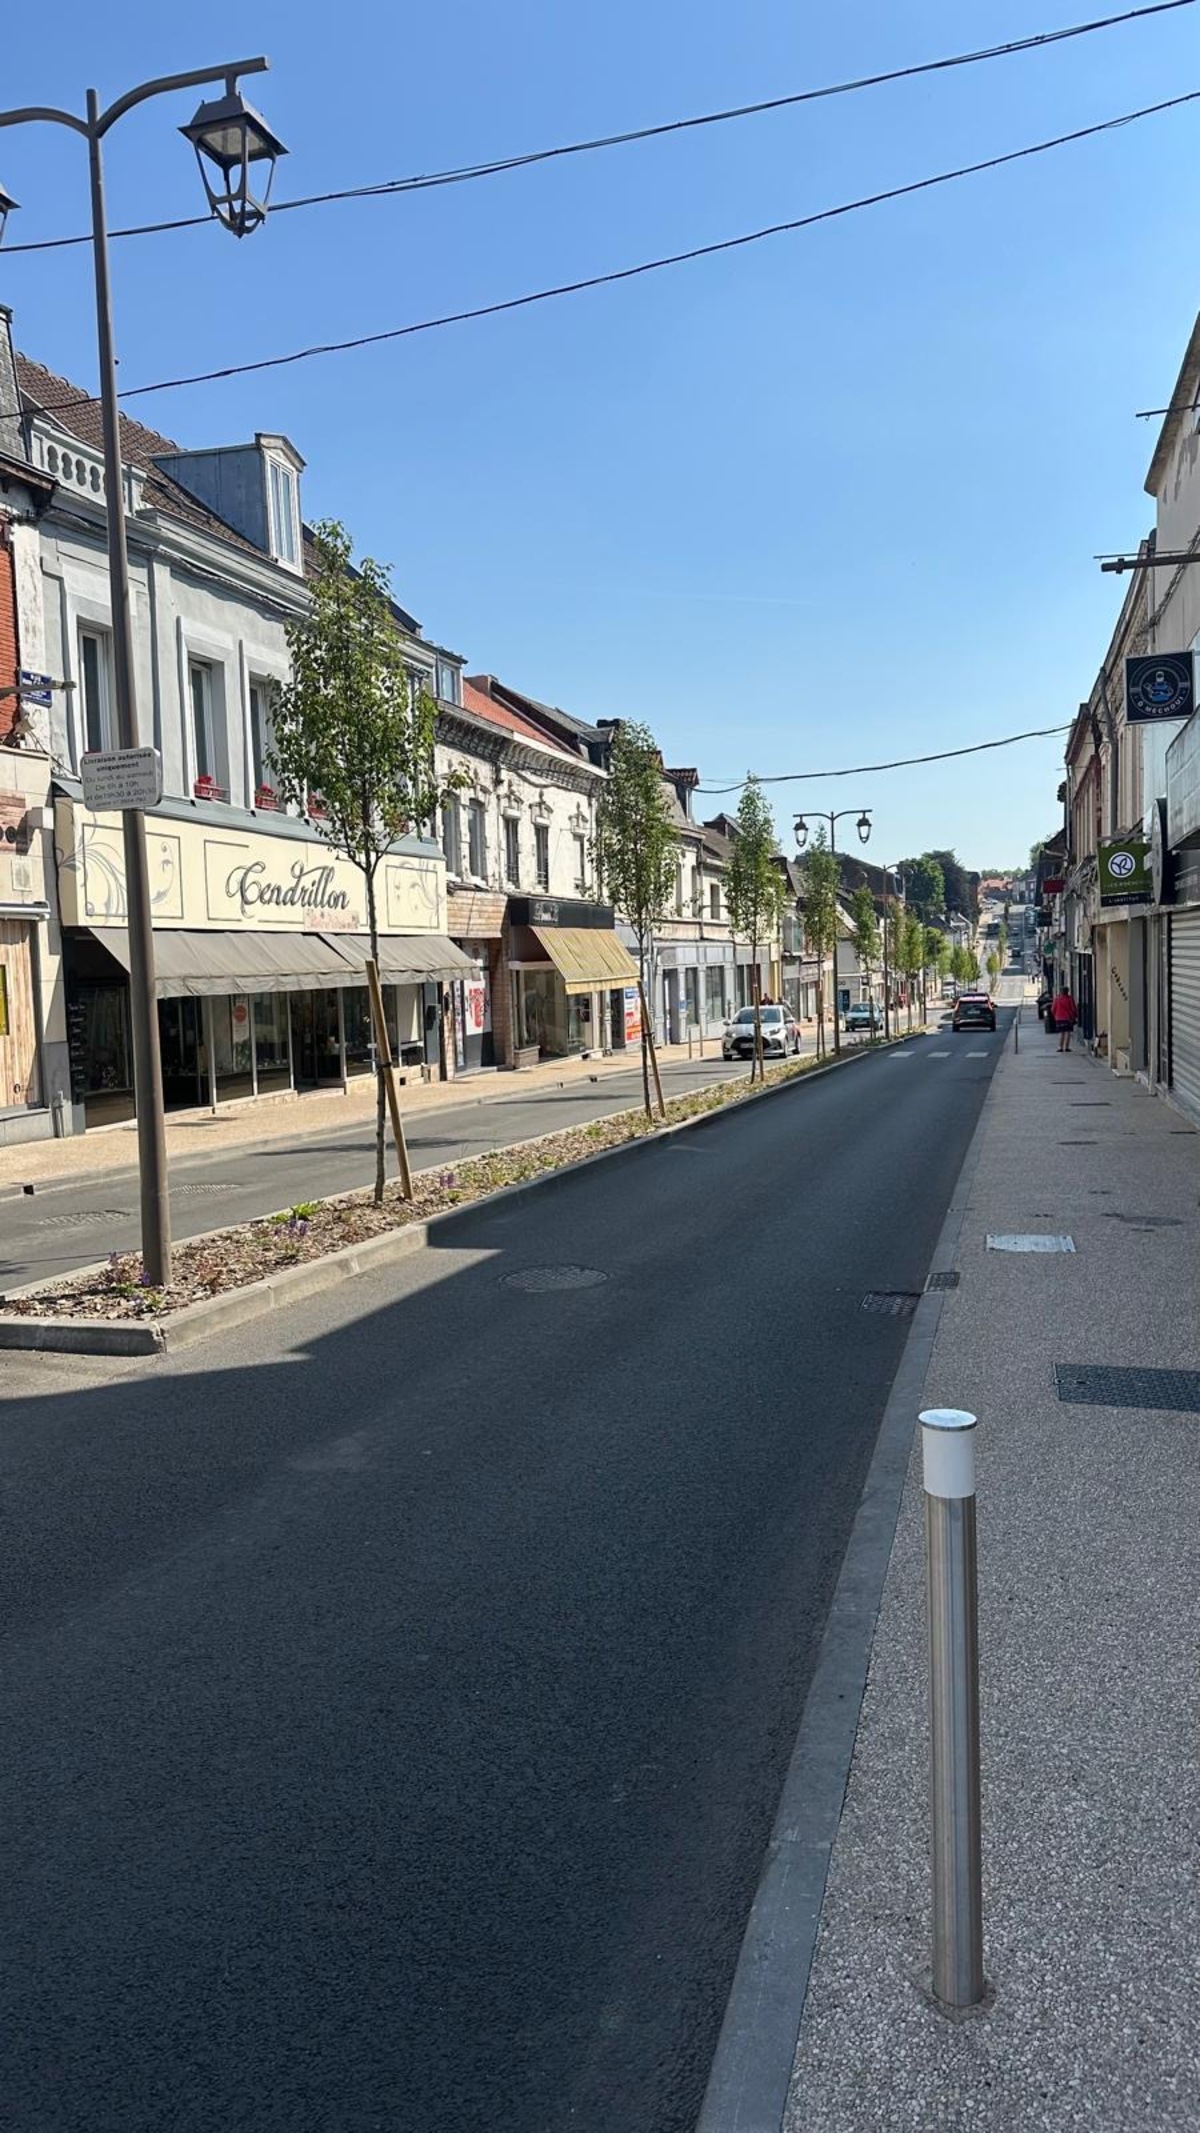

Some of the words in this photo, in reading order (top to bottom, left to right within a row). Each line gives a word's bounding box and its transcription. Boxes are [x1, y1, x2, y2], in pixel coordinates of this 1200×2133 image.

[84, 756, 116, 766] Livraison
[118, 752, 152, 762] autorisée
[96, 762, 139, 772] uniquement
[95, 784, 106, 792] De
[125, 780, 139, 788] 10h
[225, 860, 350, 918] Cendrillon
